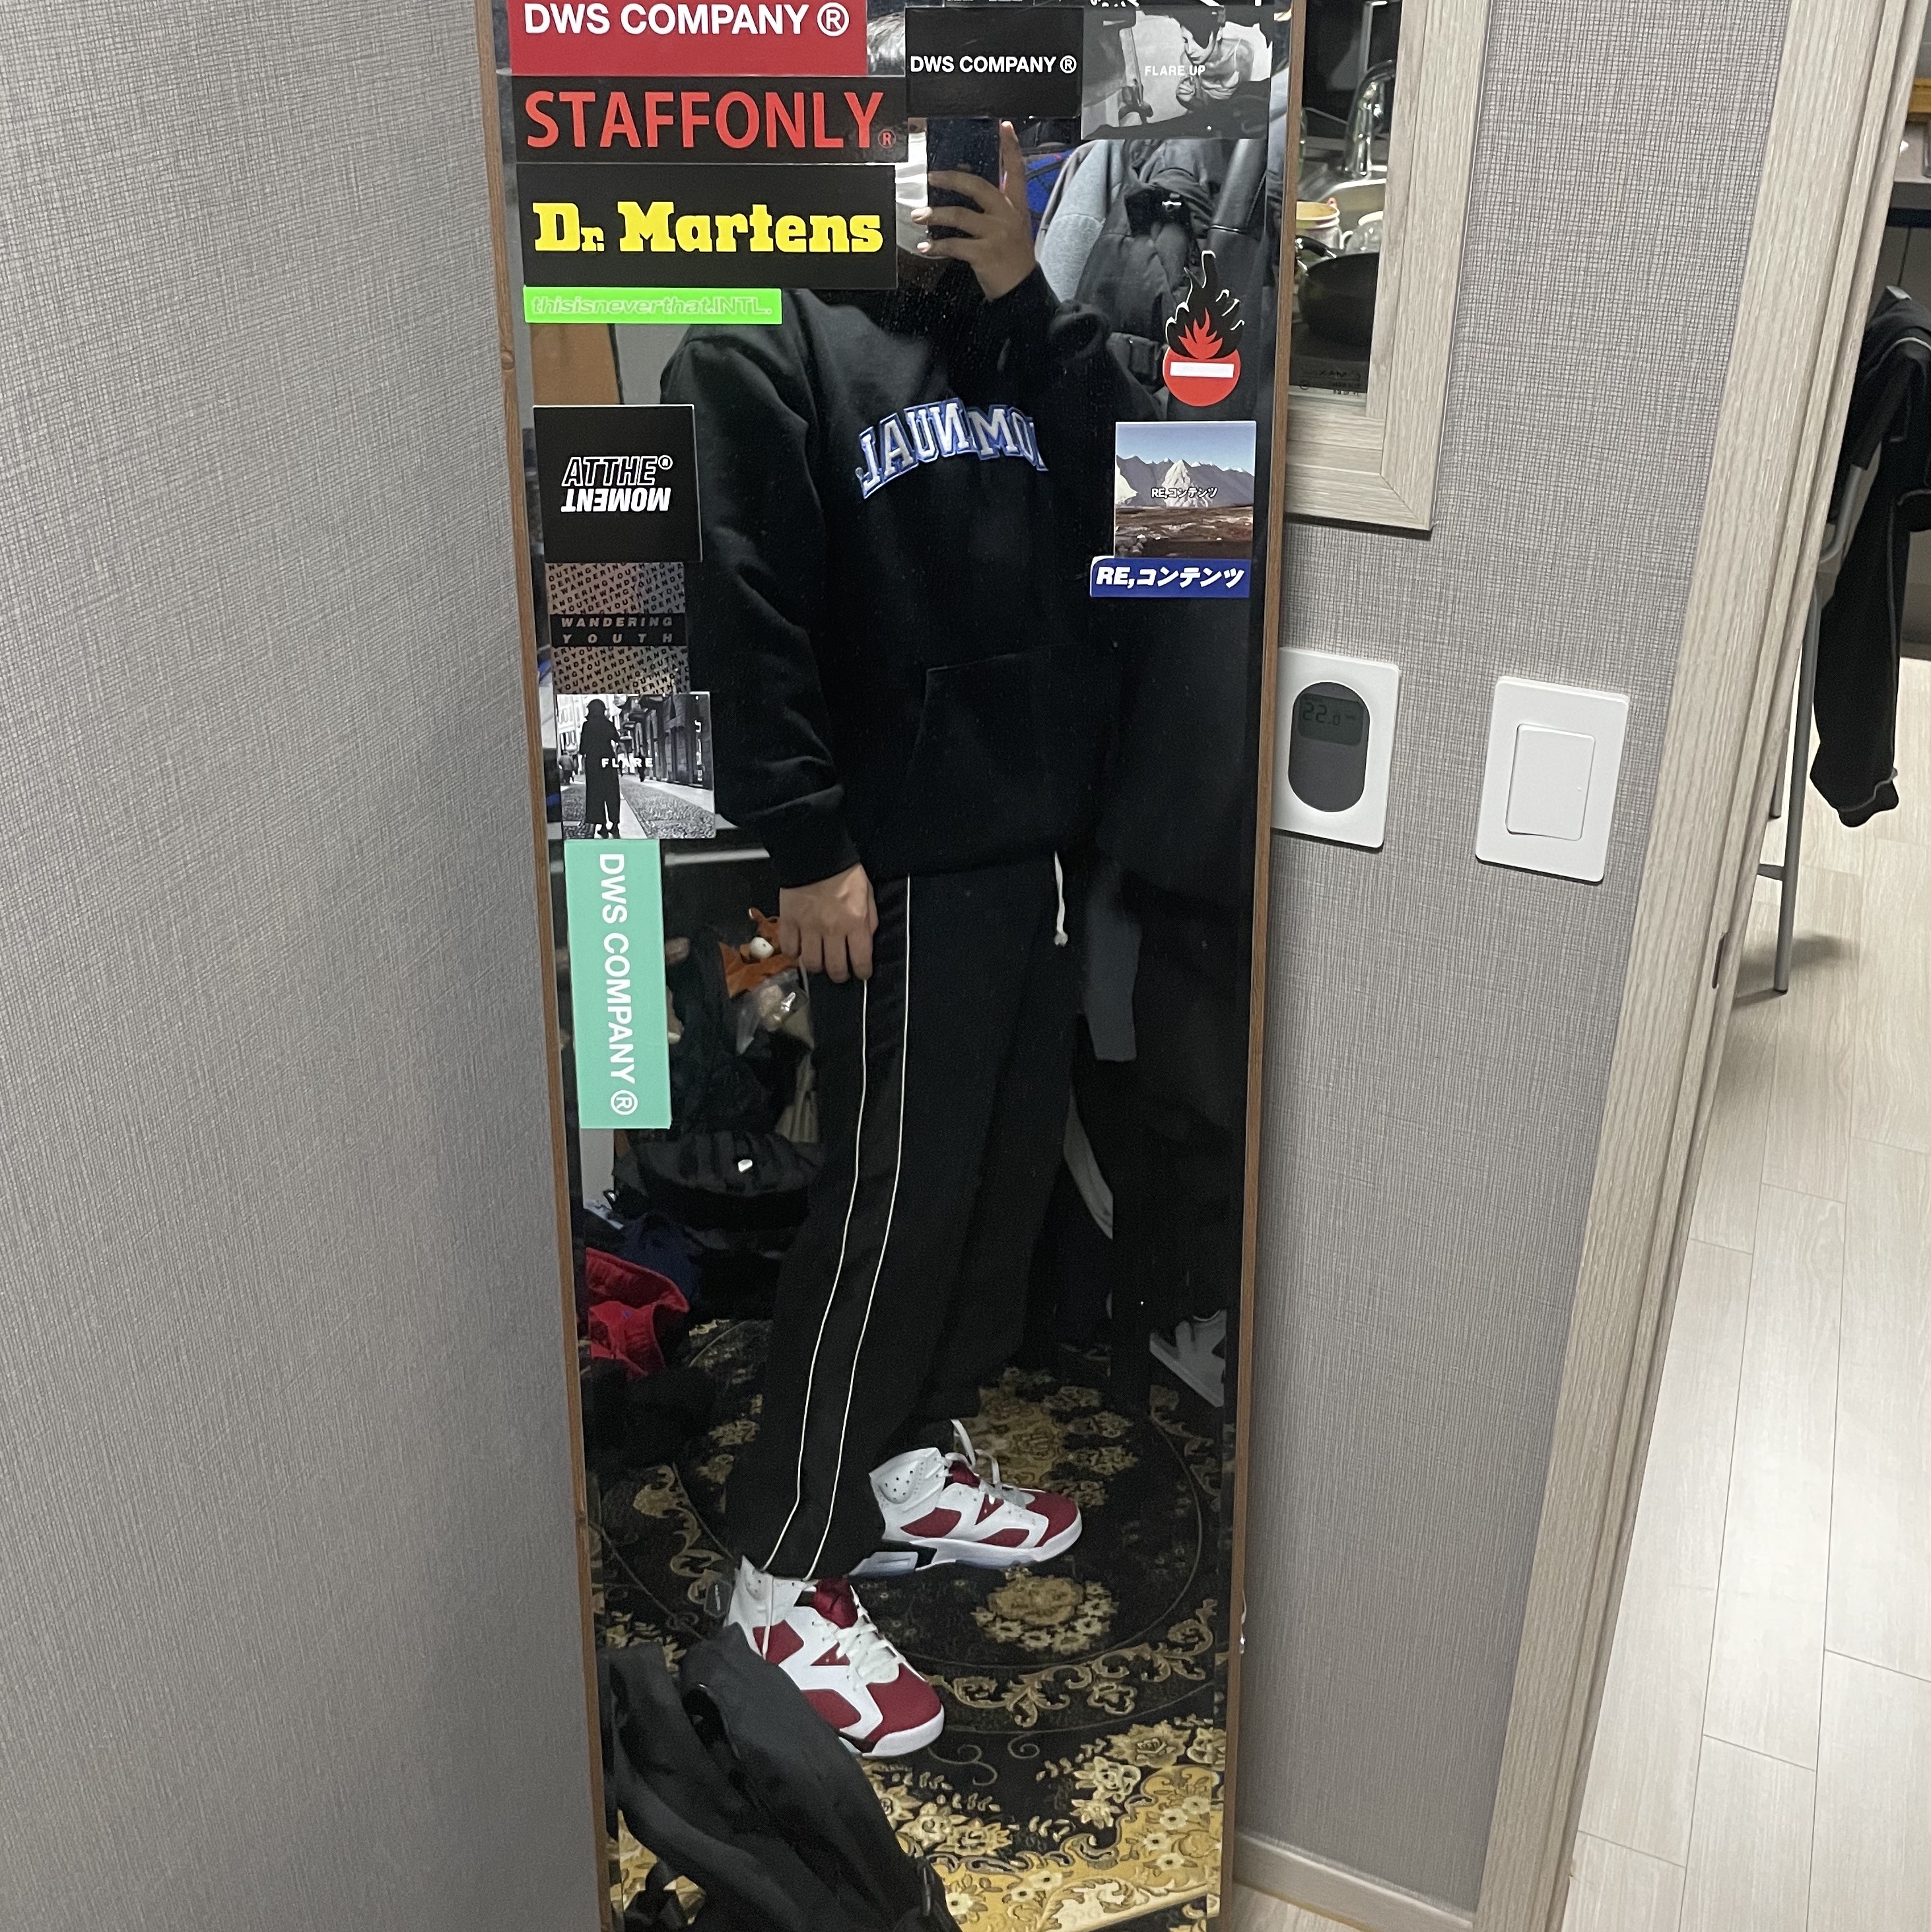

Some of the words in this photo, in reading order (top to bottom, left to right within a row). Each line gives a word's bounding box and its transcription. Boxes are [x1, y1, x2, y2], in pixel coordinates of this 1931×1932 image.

[524, 3, 611, 35] DWS
[629, 2, 809, 36] COMPANY
[910, 55, 955, 73] DWS
[959, 55, 1057, 73] COMPANY
[1145, 65, 1186, 76] FLARE
[1189, 65, 1207, 76] UP
[532, 202, 605, 252] Dr.
[617, 201, 883, 253] Martens
[560, 487, 671, 512] MOMENT
[561, 617, 673, 627] WANDERING
[563, 633, 673, 644] YOUTH
[599, 854, 628, 924] DWS
[603, 932, 636, 1084] COMPANY
